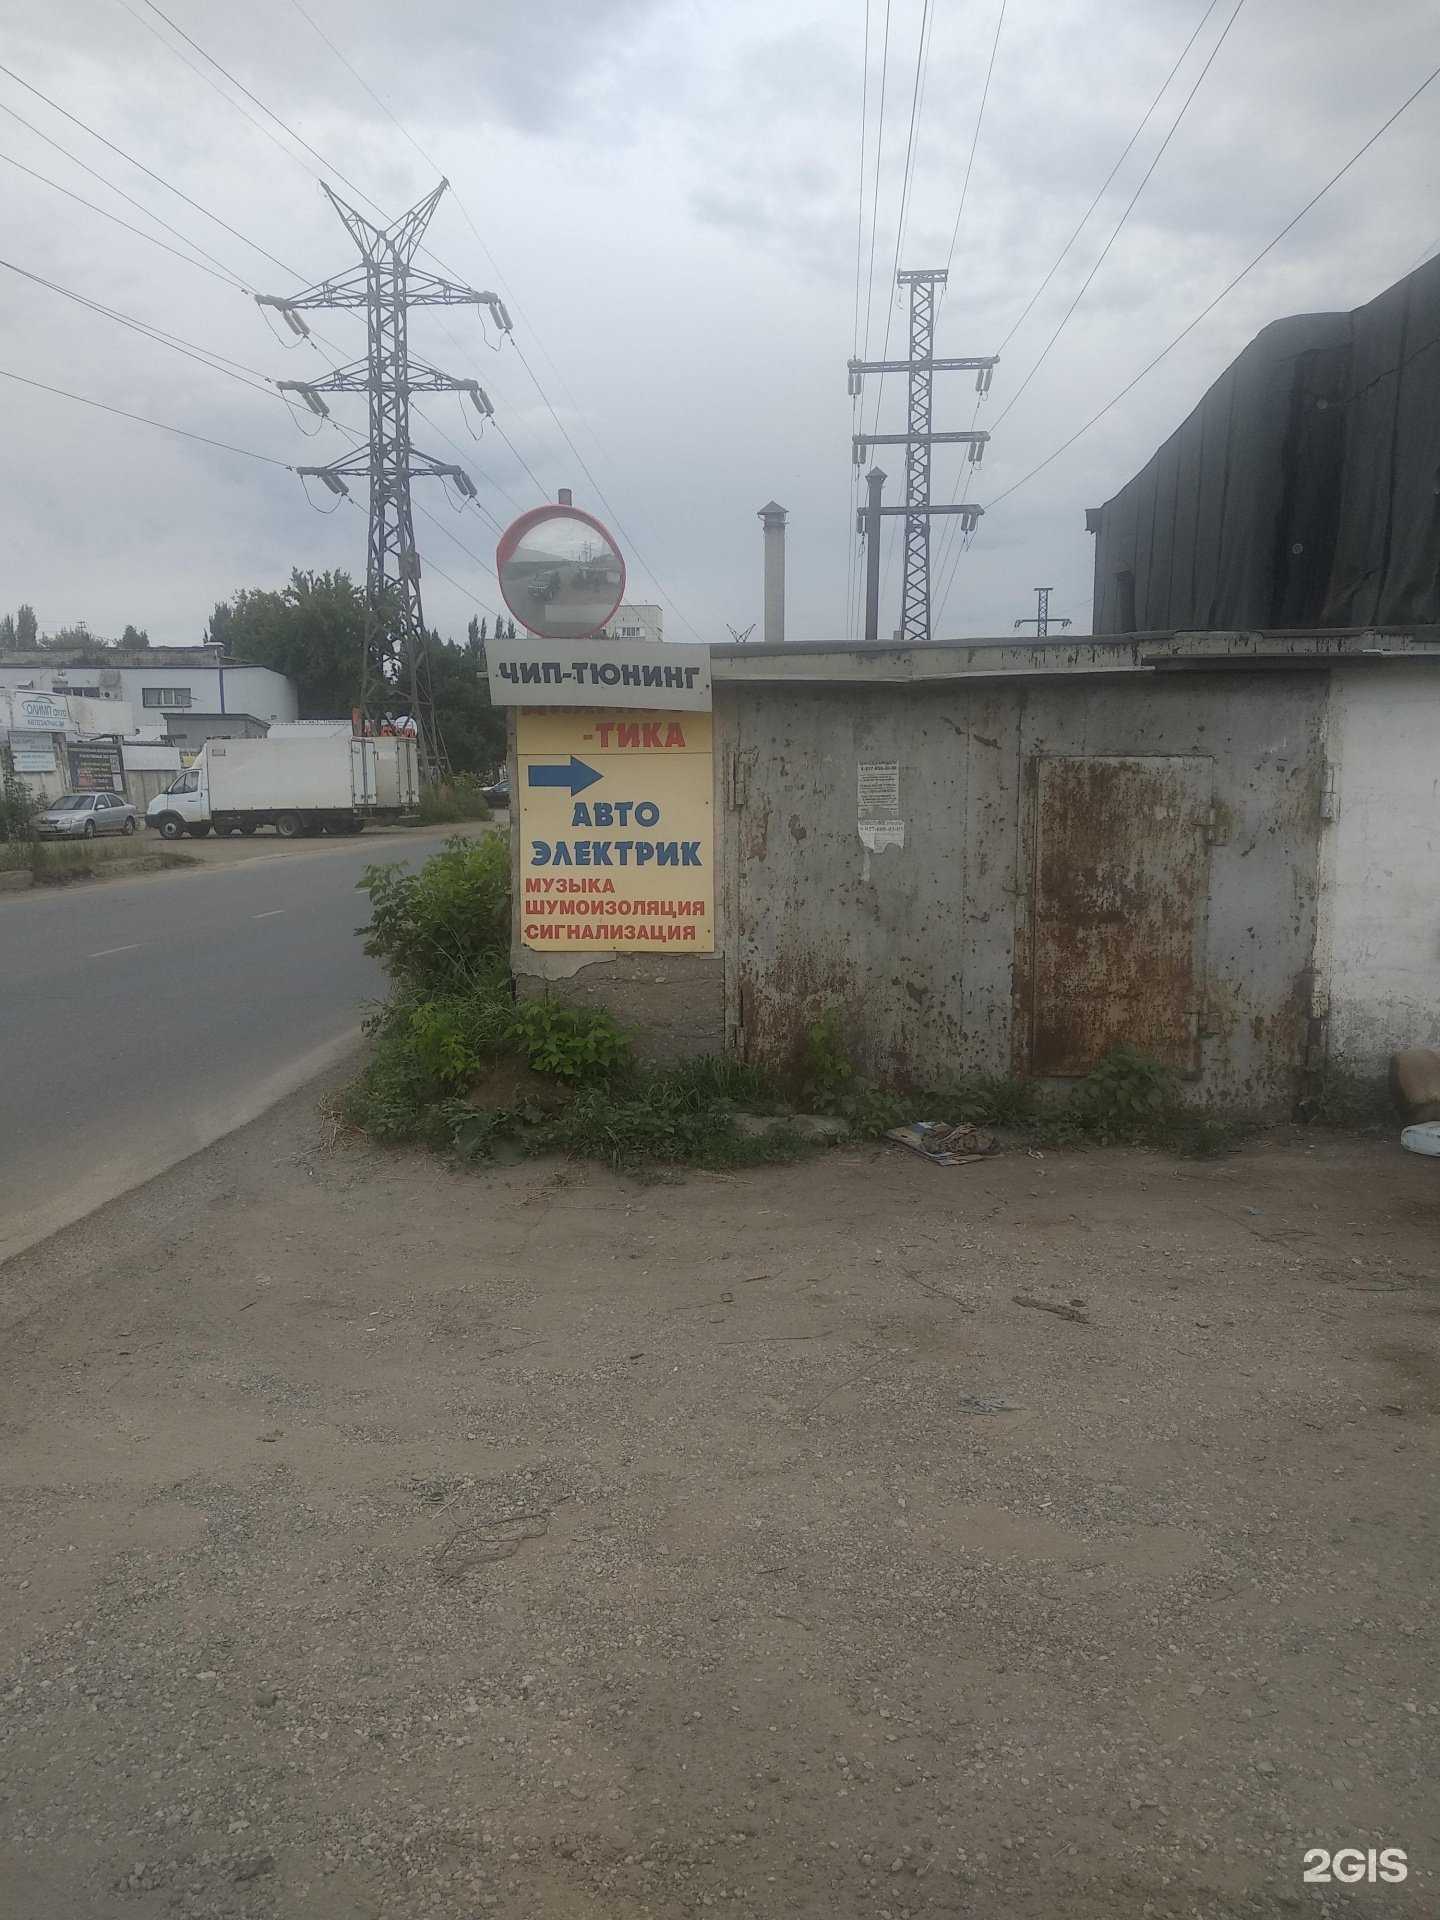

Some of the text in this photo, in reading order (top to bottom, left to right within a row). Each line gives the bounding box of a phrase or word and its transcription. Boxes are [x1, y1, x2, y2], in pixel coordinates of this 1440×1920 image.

[499, 662, 700, 689] ЧИП-ТЮНИНГ
[571, 801, 660, 827] АВТО
[530, 841, 703, 866] ЭЛЕКТРИК
[525, 878, 615, 893] МУЗЫКА
[525, 901, 705, 918] ШУМОИЗОЛЯЦИЯ
[525, 924, 696, 941] СИГНАЛИЗАЦИЯ
